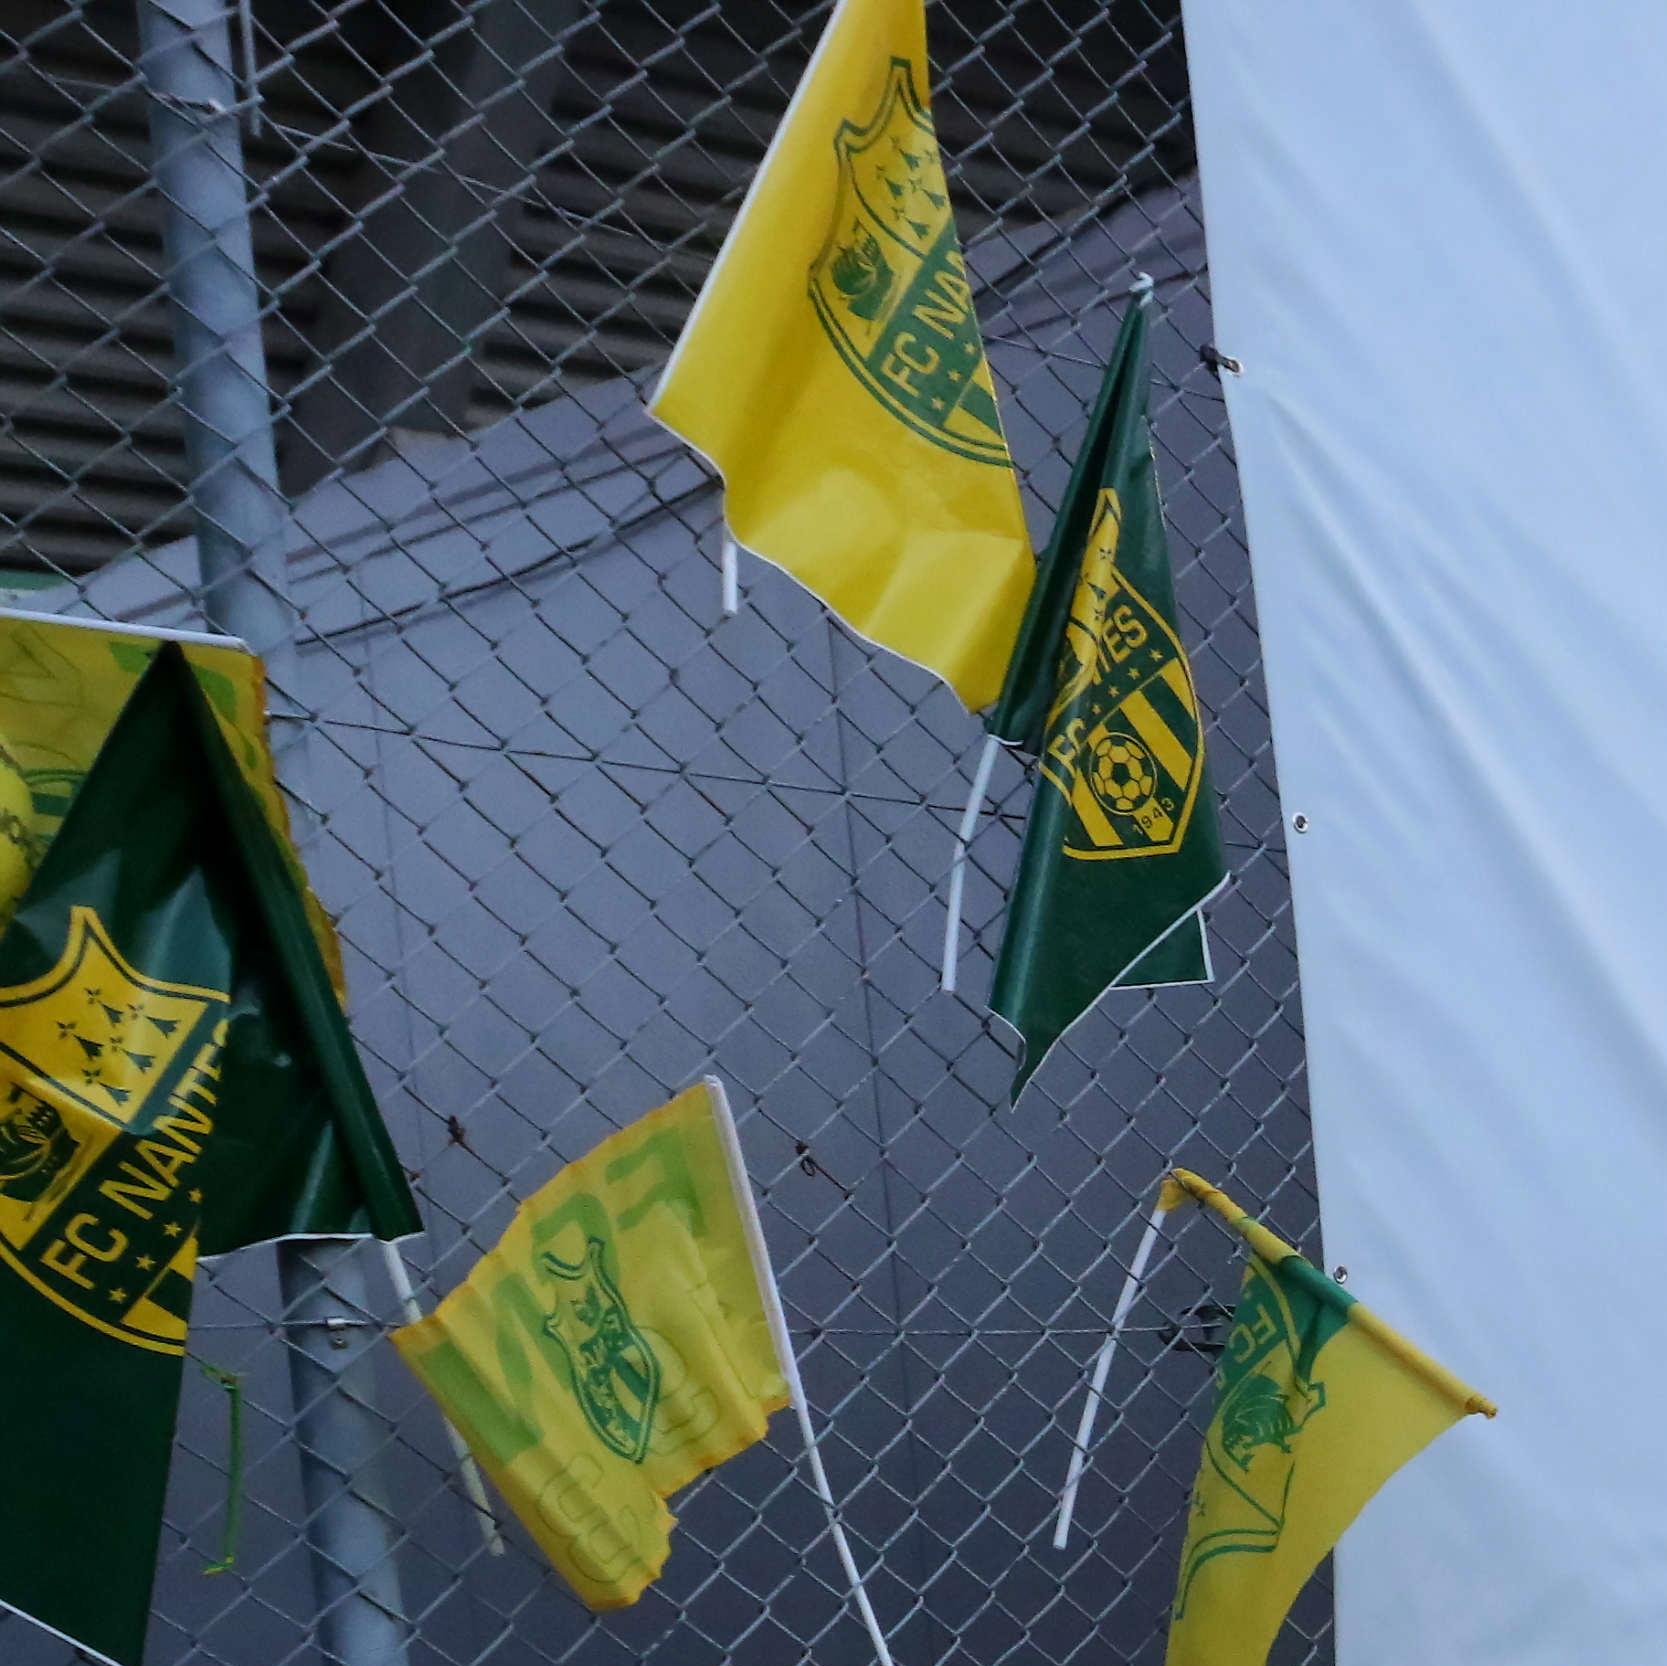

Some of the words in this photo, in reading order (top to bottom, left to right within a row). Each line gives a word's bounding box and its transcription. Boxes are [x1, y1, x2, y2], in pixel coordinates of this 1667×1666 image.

[880, 331, 940, 398] FC
[1131, 796, 1177, 836] 1943
[40, 1212, 129, 1290] FC
